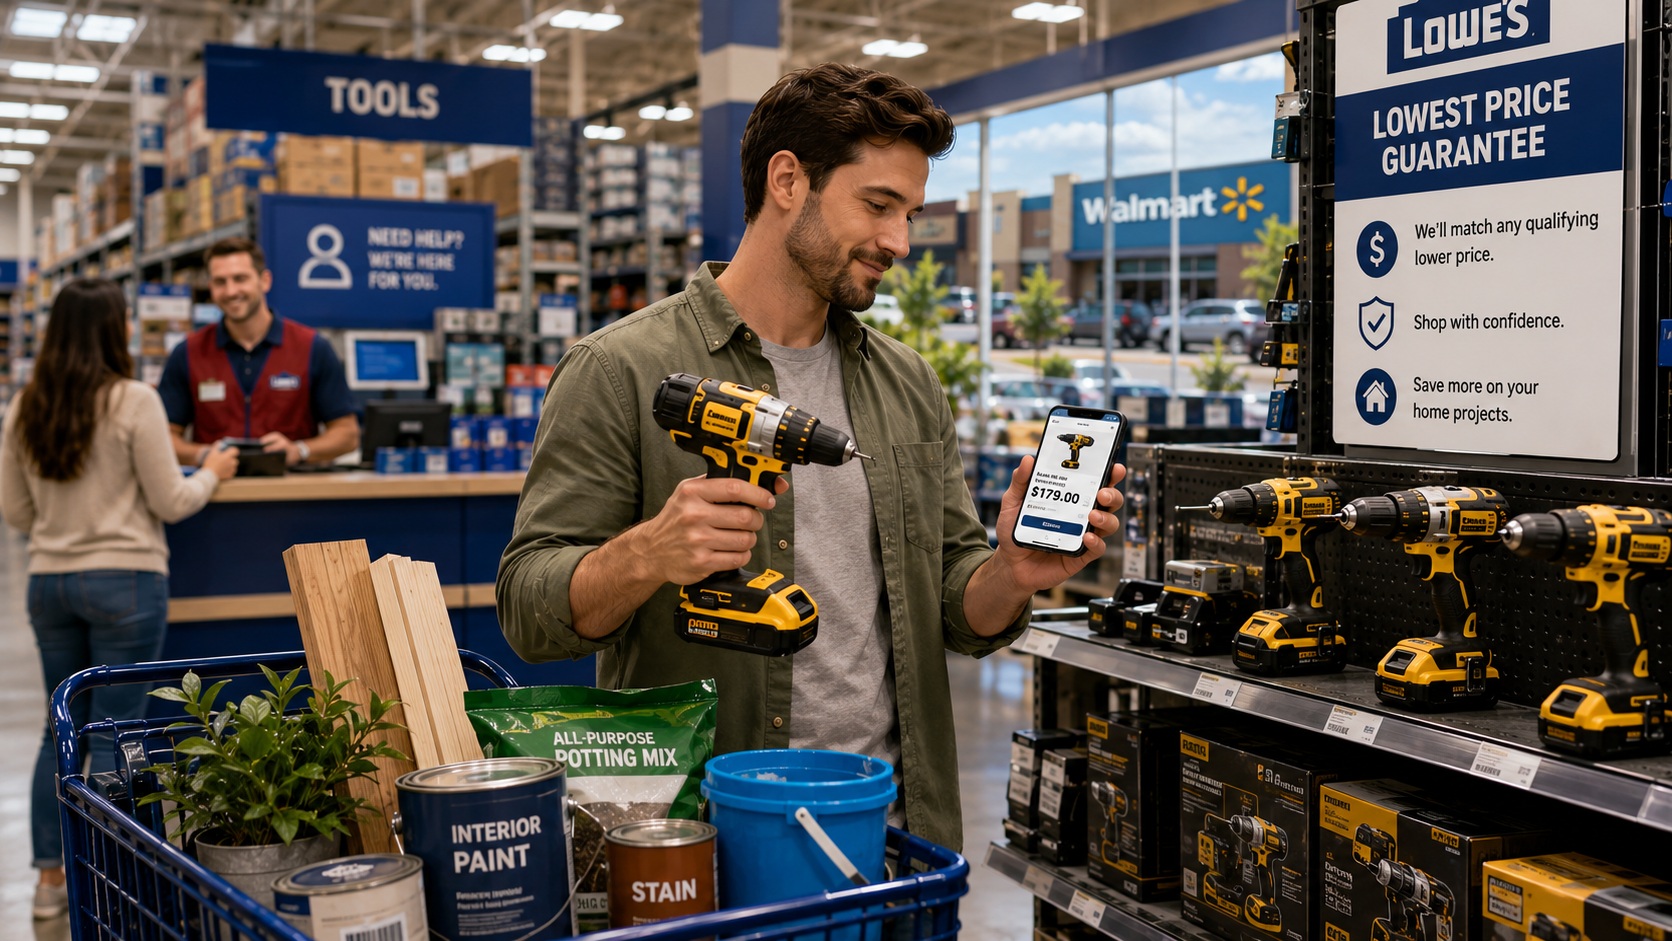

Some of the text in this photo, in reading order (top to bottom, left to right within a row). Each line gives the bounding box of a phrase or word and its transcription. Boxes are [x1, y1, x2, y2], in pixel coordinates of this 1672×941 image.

[325, 77, 439, 119] TOOLS
[1374, 77, 1570, 139] LOWEST PRICE
[1382, 124, 1545, 176] GUARANTEE
[1082, 187, 1217, 225] Walmart
[1414, 210, 1598, 240] We'll match any qualifying
[368, 227, 465, 249] NEED HELP?
[368, 251, 455, 270] WE'RE HERE
[1415, 246, 1494, 268] lower price.
[368, 271, 438, 290] FOR YOU.
[1414, 312, 1564, 334] Shop with confidence.
[1414, 376, 1540, 398] Save more on your
[1414, 402, 1512, 424] home projects.
[1030, 486, 1080, 504] $179.00
[554, 731, 655, 745] ALL-PURPOSE
[555, 748, 678, 768] POTTING MIX
[452, 815, 541, 844] INTERIOR
[453, 843, 530, 873] PAINT
[632, 879, 696, 902] STAIN
